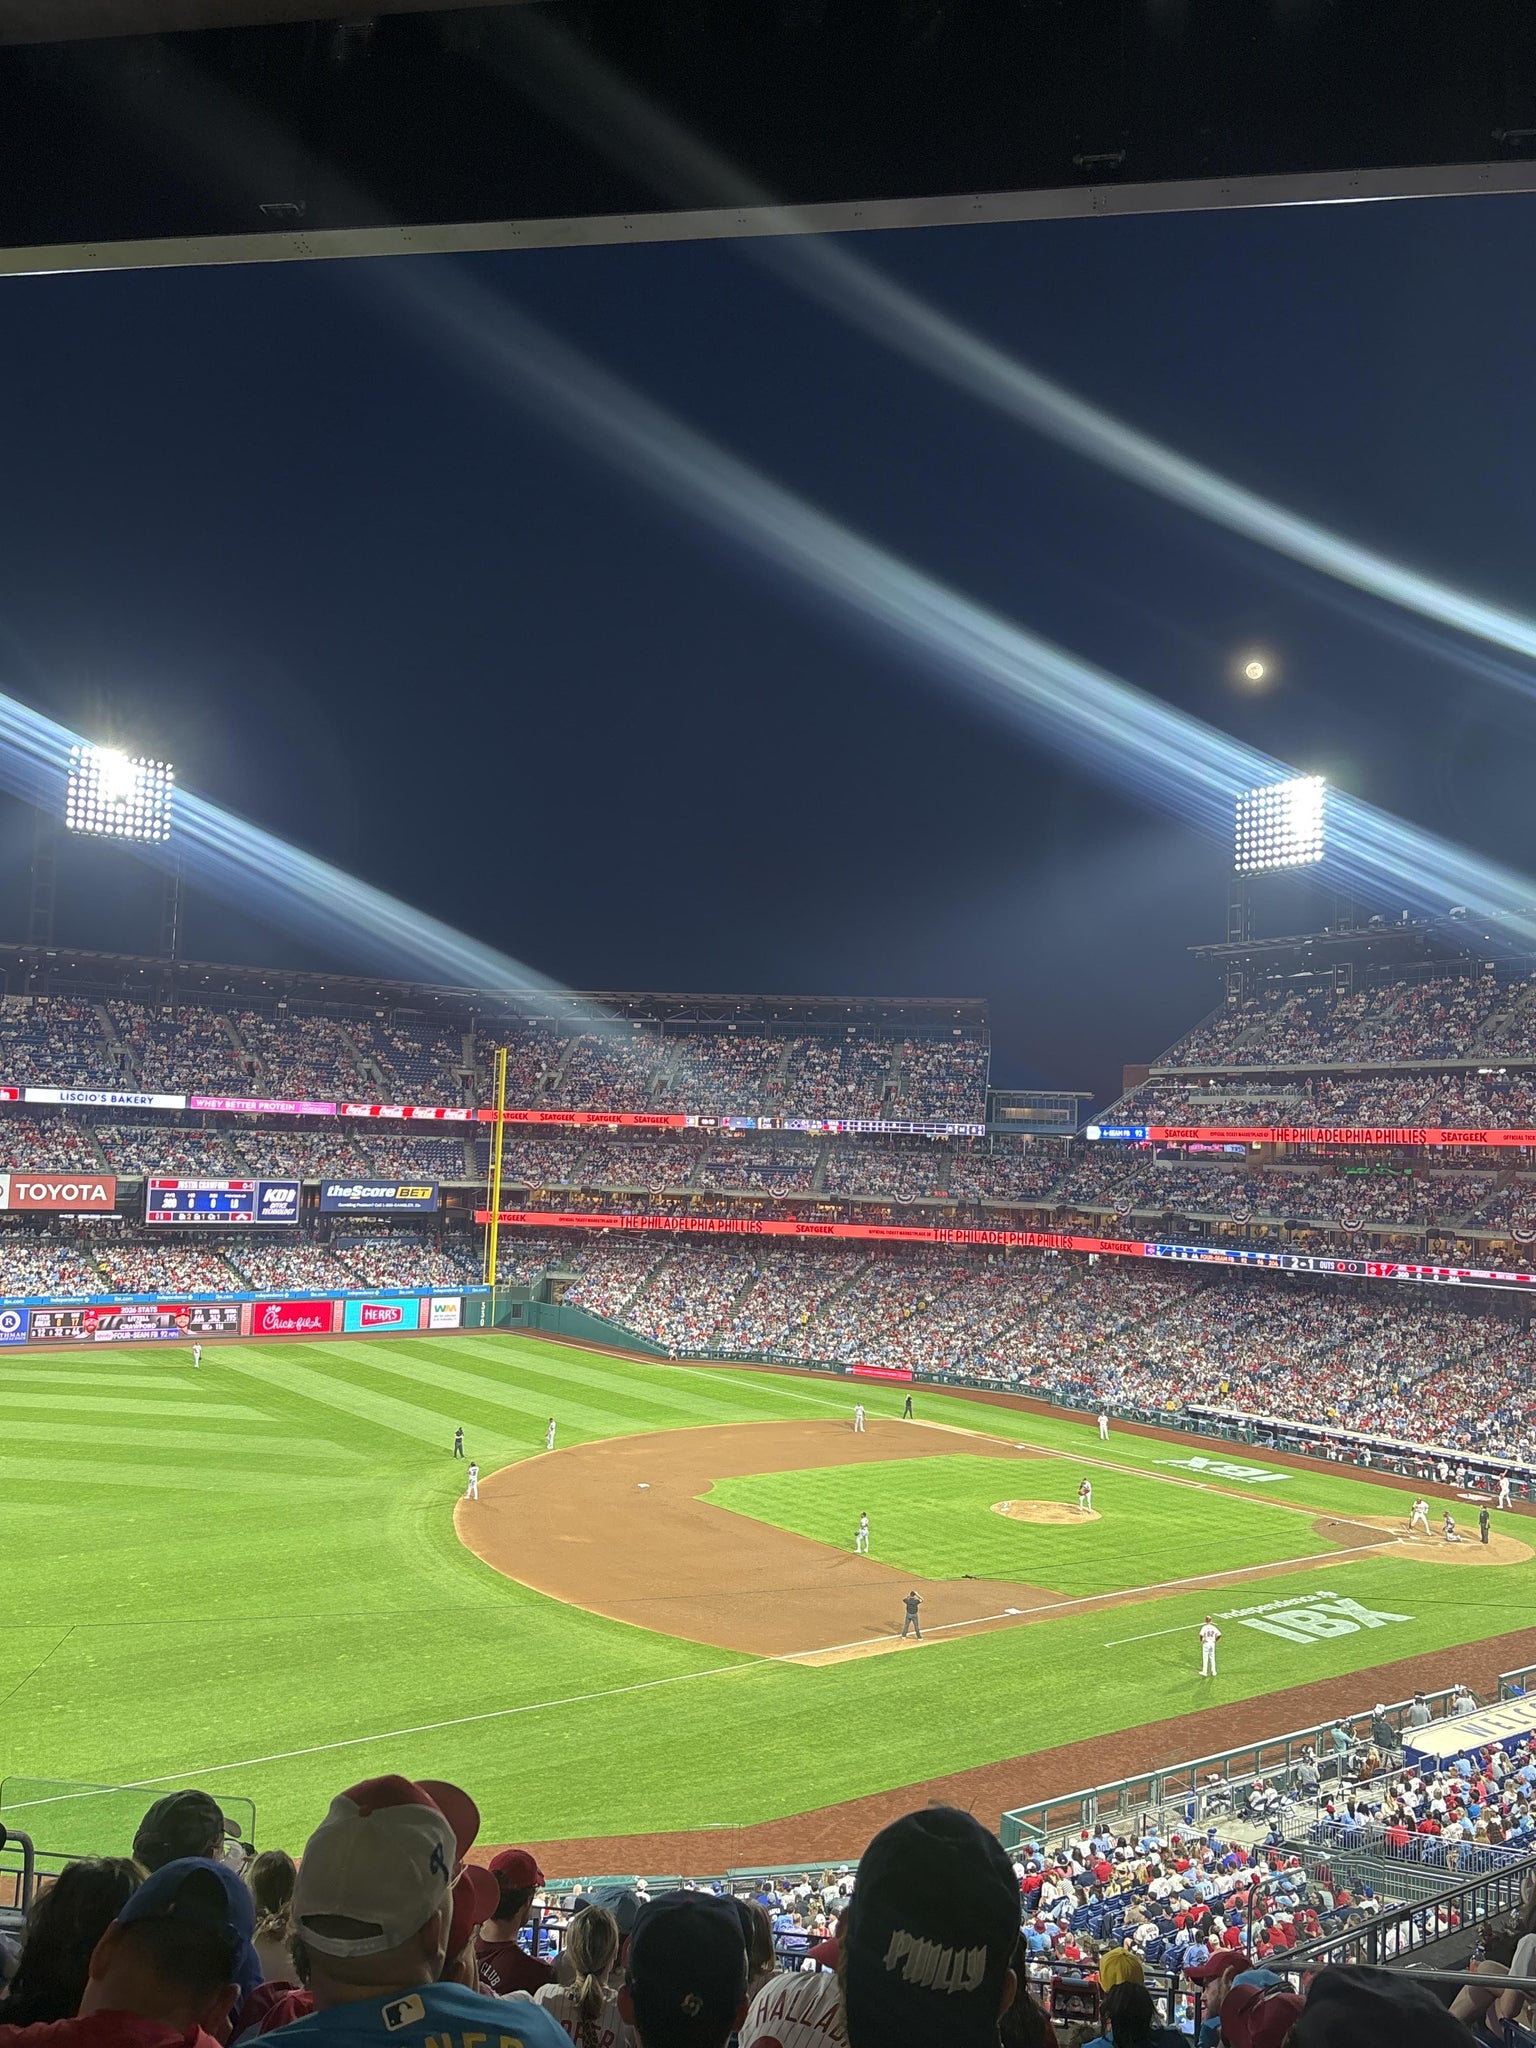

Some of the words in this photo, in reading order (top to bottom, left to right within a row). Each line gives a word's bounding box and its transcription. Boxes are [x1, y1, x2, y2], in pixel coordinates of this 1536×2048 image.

[60, 1092, 107, 1102] LISCIO'S
[111, 1095, 154, 1104] BAKERY
[196, 1100, 223, 1108] WHEY
[226, 1101, 256, 1109] BETTER
[259, 1103, 295, 1111] PROTEIN
[493, 1112, 528, 1121] SATGEEK
[540, 1113, 575, 1122] SEATGEEK
[587, 1114, 622, 1123] SEATGEEK
[634, 1115, 669, 1124] SEATGEEK
[1135, 1129, 1143, 1137] 92
[1165, 1128, 1199, 1138] SEATGEEK
[1271, 1128, 1290, 1141] THE
[1293, 1129, 1372, 1143] PHILADELPHIA
[1376, 1129, 1426, 1144] PHILLIES
[1441, 1131, 1488, 1143] SEATGEEK
[15, 1183, 107, 1201] TOYOTA
[263, 1188, 296, 1202] KDI
[327, 1185, 396, 1198] theScore
[400, 1188, 429, 1197] BET
[620, 1216, 638, 1227] THE
[641, 1217, 715, 1231] PHILADELPHIA
[718, 1219, 762, 1233] PHILLIES
[796, 1224, 834, 1234] SEATGEEK
[934, 1229, 953, 1241] THE
[956, 1231, 1035, 1245] PHILADELPHIA
[1037, 1235, 1073, 1248] PHILLIES
[1100, 1241, 1132, 1253] SEATGEEK
[1320, 1260, 1335, 1270] OUTS
[434, 1304, 457, 1313] WM
[364, 1309, 398, 1321] HERR'S
[5, 1317, 13, 1326] R
[160, 1330, 168, 1338] 92
[1214, 1594, 1320, 1619] Independence
[1238, 1598, 1417, 1644] IBX
[1452, 1703, 1536, 1737] WELC
[1203, 1885, 1212, 1896] 12
[480, 1961, 501, 1988] CLUB
